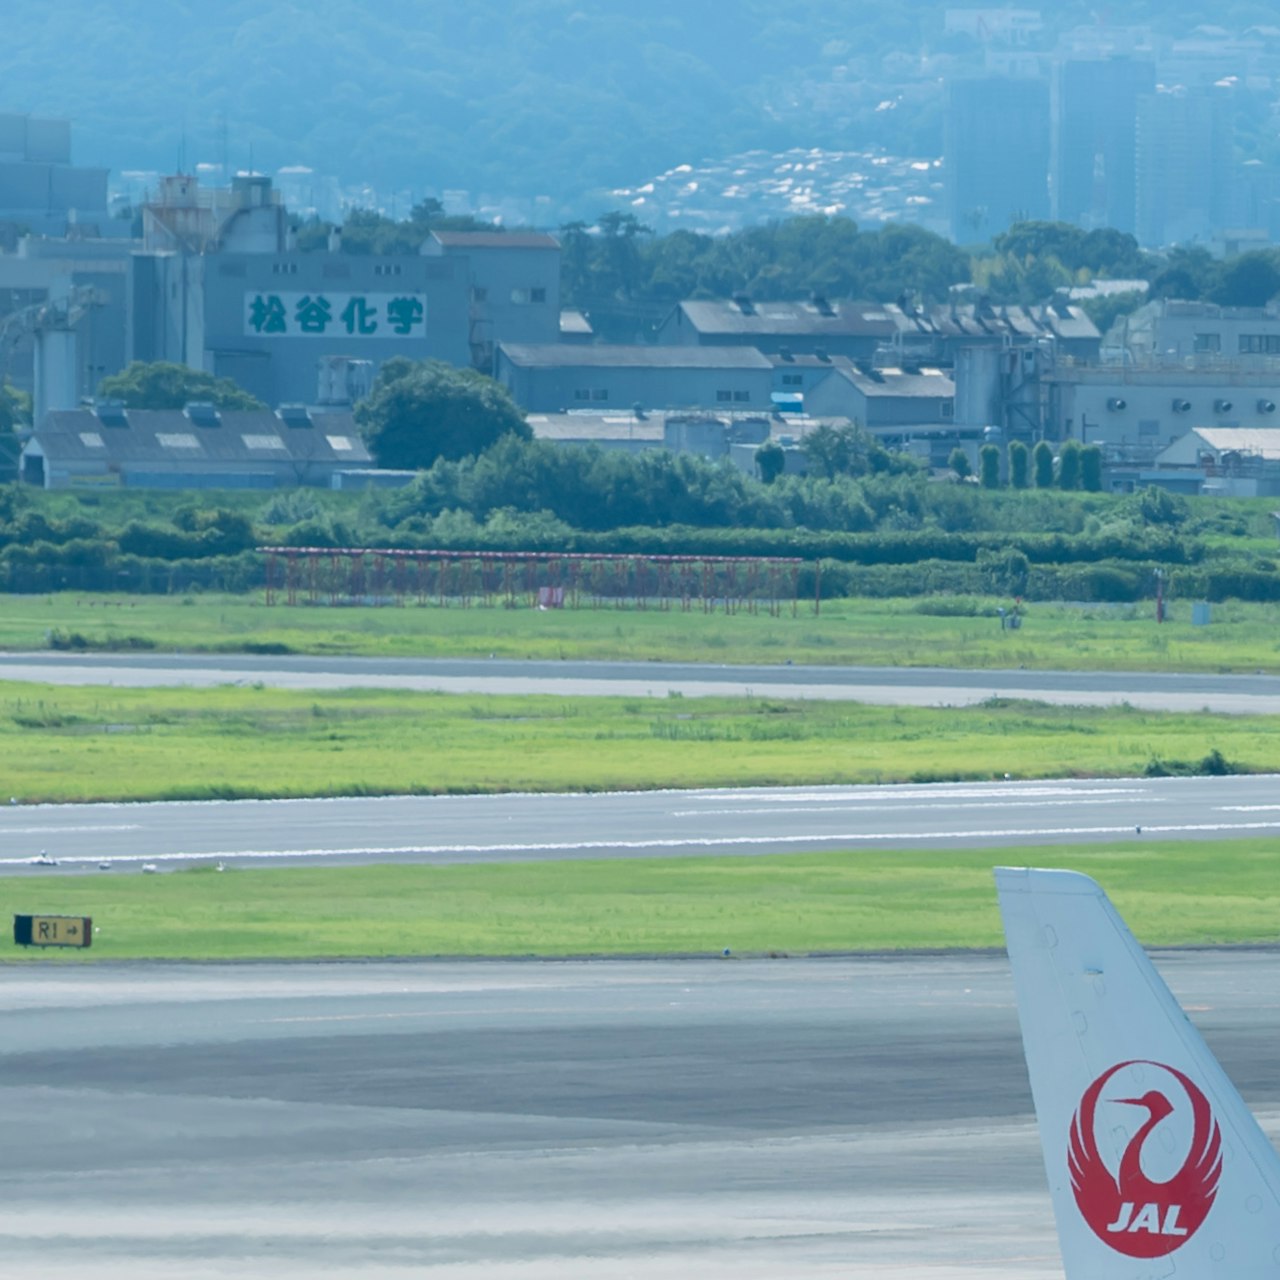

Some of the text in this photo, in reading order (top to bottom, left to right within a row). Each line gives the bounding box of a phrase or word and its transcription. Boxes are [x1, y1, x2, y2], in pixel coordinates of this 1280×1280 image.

[249, 295, 423, 334] 松谷化学
[1106, 1202, 1188, 1235] JAL
